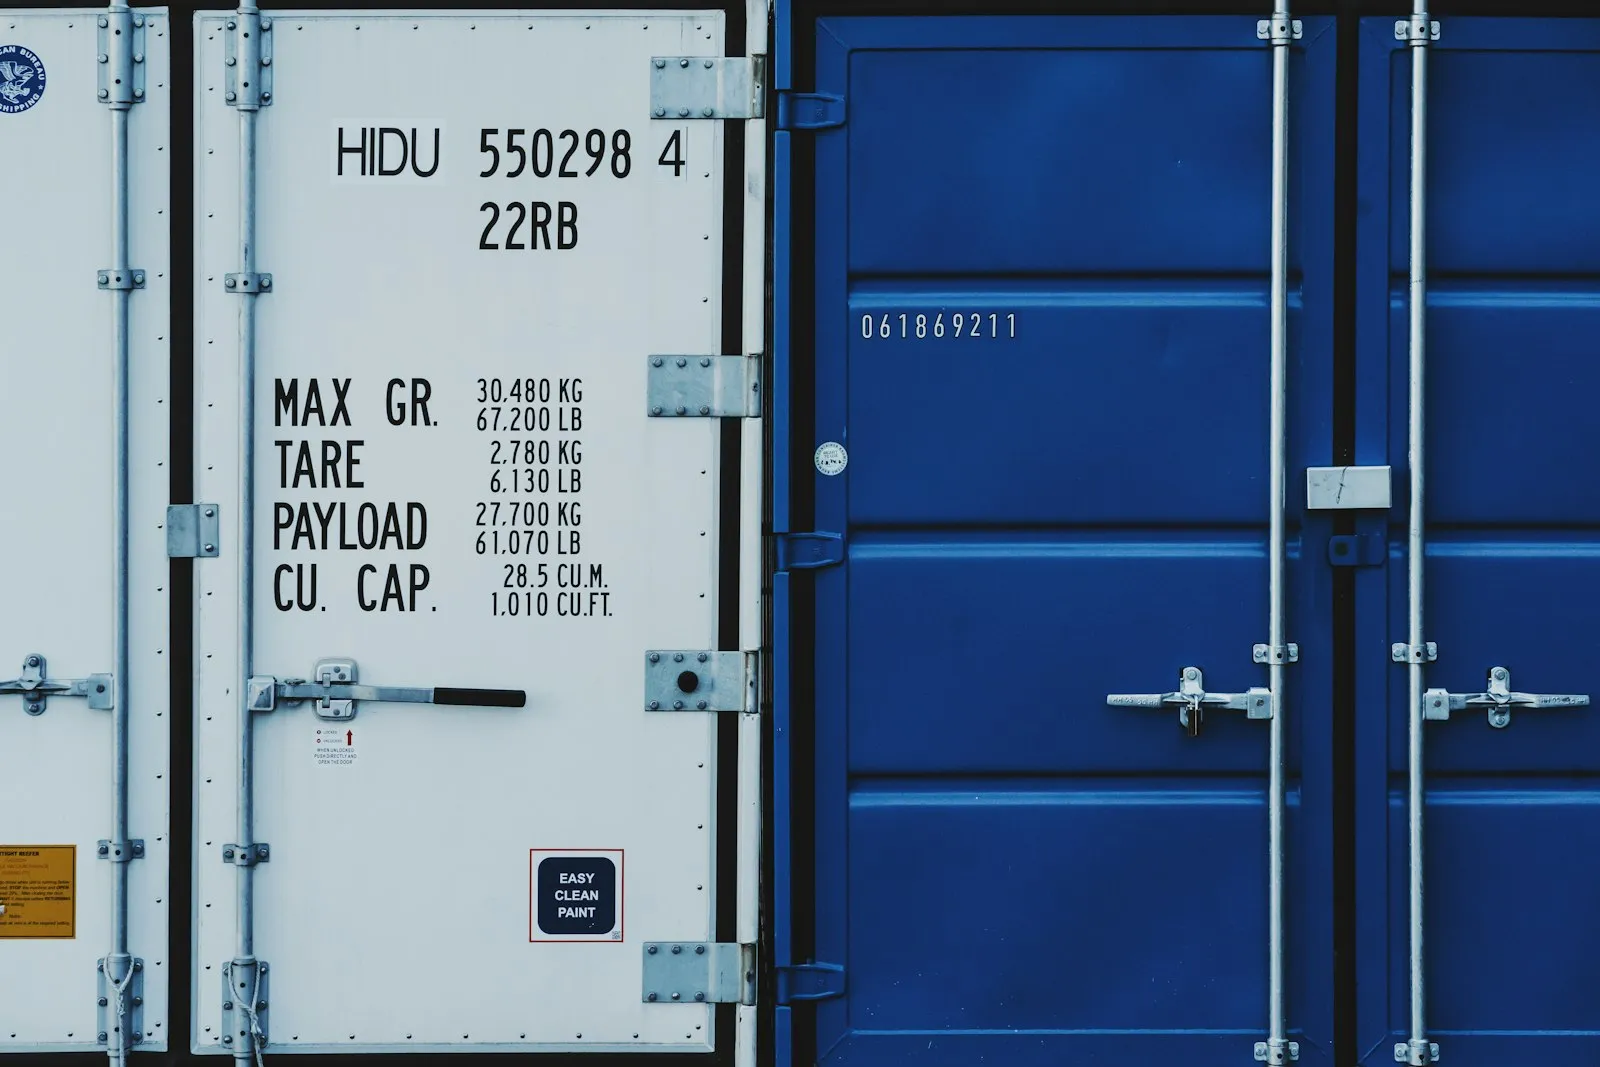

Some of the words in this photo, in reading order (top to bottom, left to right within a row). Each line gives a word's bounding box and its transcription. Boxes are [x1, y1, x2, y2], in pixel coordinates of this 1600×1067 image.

[20, 48, 46, 80] BUREAU
[337, 127, 440, 178] HIDU
[479, 128, 632, 178] 550298
[658, 129, 686, 177] 4
[479, 201, 578, 250] 22RB
[861, 313, 1015, 339] 061869211
[274, 378, 352, 427] MAX
[385, 377, 438, 427] GR.
[477, 378, 550, 404] 30,480
[558, 378, 583, 403] KG
[476, 406, 550, 432] 67,200
[558, 406, 582, 431] LB
[274, 439, 365, 489] TARE
[490, 440, 550, 465] 2,780
[558, 440, 582, 465] KG
[490, 468, 550, 494] 6,130
[558, 468, 582, 493] LB
[273, 501, 428, 550] PAYLOAD
[475, 501, 549, 527] 27,700
[557, 501, 581, 526] KG
[475, 530, 549, 556] 61,070
[557, 530, 581, 555] LB
[273, 563, 326, 612] CU.
[357, 563, 437, 612] CAP.
[503, 563, 548, 589] 28.5
[557, 563, 608, 589] CU.M.
[491, 591, 548, 617] 1,010
[557, 591, 613, 617] CU.FT.
[559, 872, 595, 884] EASY
[554, 889, 599, 901] CLEAN
[557, 906, 596, 918] PAINT
